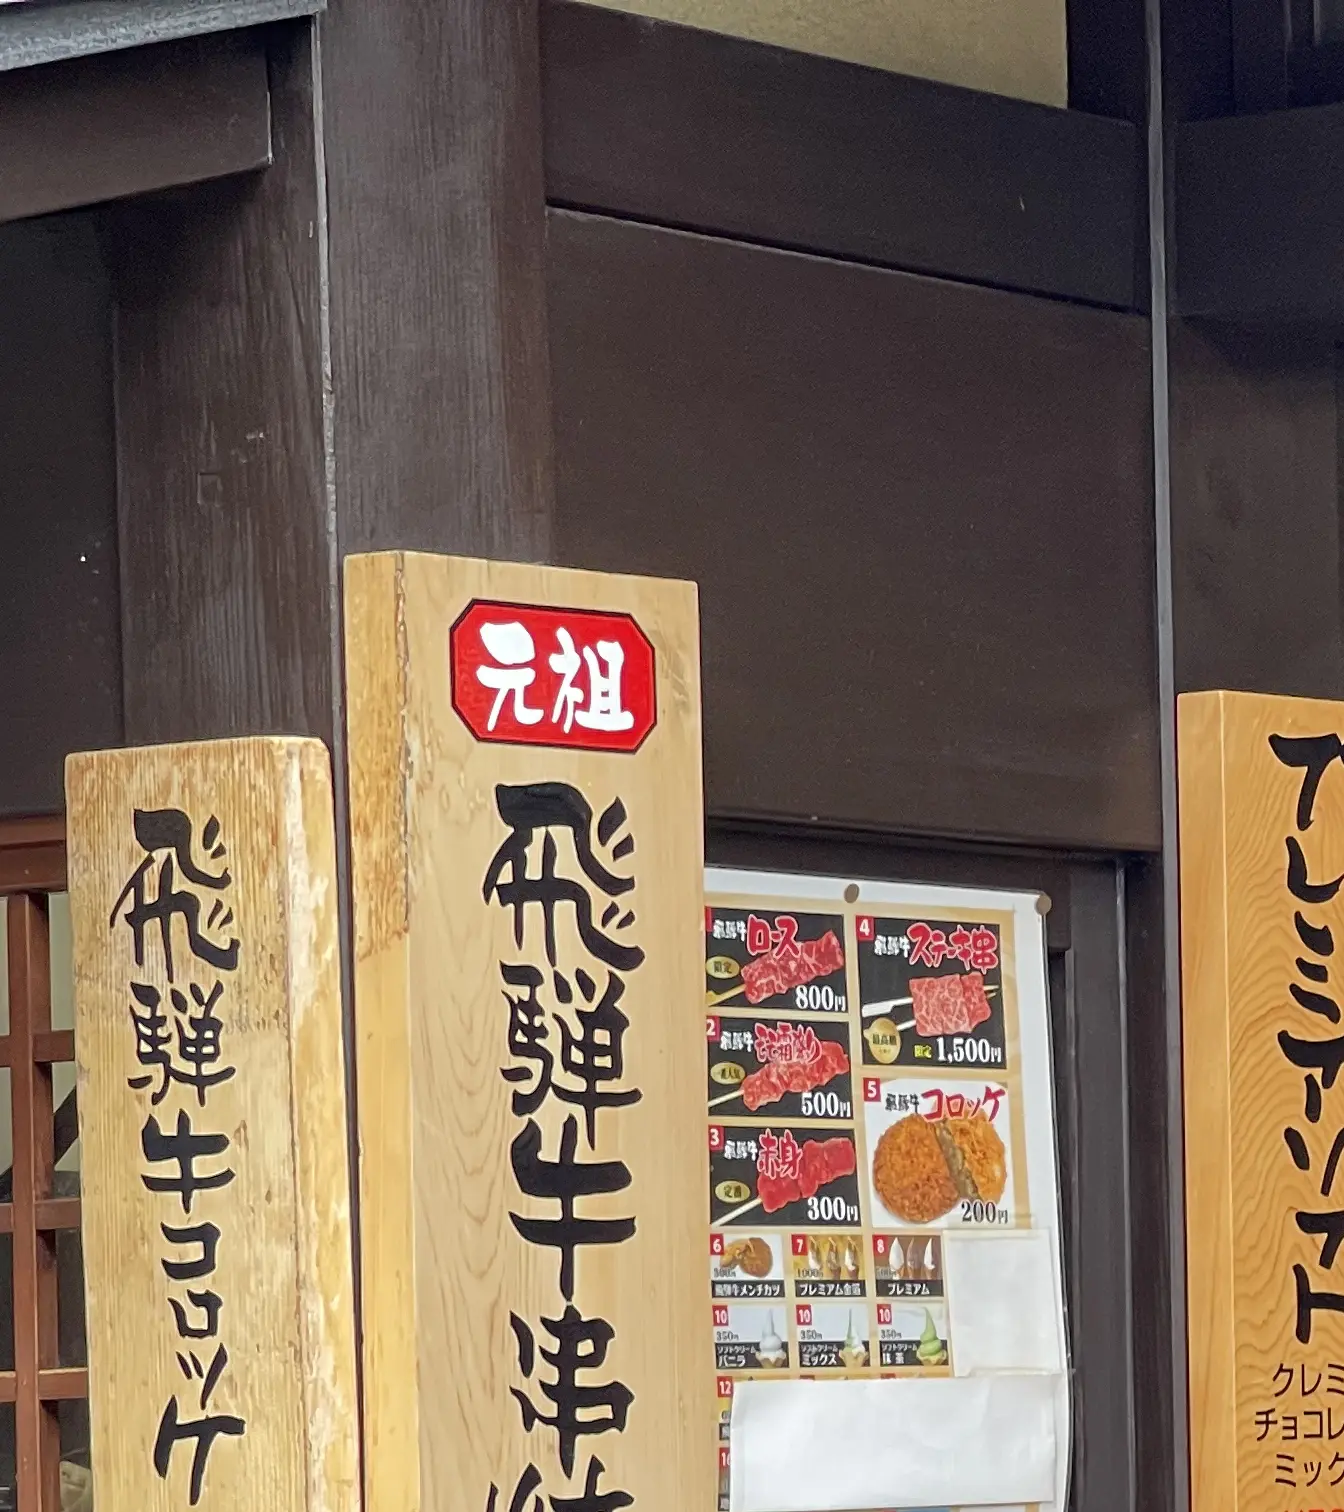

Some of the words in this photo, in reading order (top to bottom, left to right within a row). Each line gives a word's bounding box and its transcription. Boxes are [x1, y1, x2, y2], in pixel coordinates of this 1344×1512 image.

[475, 619, 634, 733] 元祖
[859, 918, 871, 936] 4
[746, 913, 802, 960] ロース
[906, 921, 999, 975] ステーキ串
[795, 984, 847, 1012] 800円
[706, 1018, 716, 1037] 2
[935, 1036, 1002, 1064] 1,500円
[866, 1081, 877, 1097] 5
[801, 1091, 851, 1118] 500円
[921, 1086, 1007, 1122] コロッケ
[709, 1128, 720, 1146] 3
[109, 807, 247, 1507] 飛騨牛コロッケ
[756, 1127, 804, 1180] 赤身
[807, 1195, 859, 1222] 300円
[960, 1200, 1009, 1224] 200円
[712, 1237, 722, 1253] 6
[796, 1238, 804, 1253] 7
[887, 1282, 930, 1296] プレミアム
[714, 1309, 728, 1325] 10
[798, 1308, 812, 1324] 10
[879, 1308, 892, 1323] 10
[718, 1355, 746, 1368] バニラ
[801, 1353, 838, 1367] ミックス
[719, 1380, 732, 1395] 12
